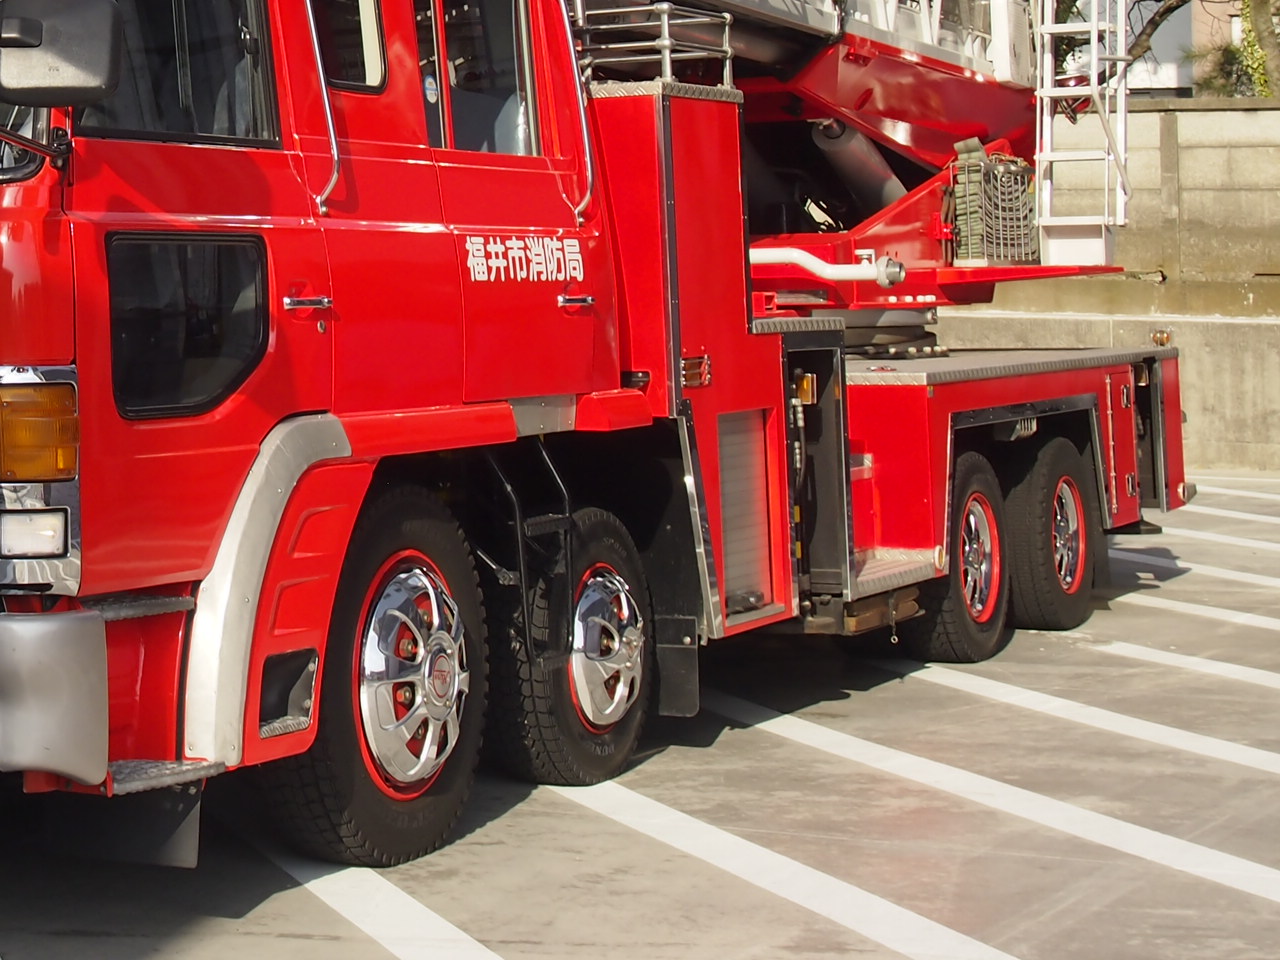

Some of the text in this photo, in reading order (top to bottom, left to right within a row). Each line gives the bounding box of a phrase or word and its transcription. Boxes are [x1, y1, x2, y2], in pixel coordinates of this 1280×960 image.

[465, 235, 584, 282] 福井市消防局
